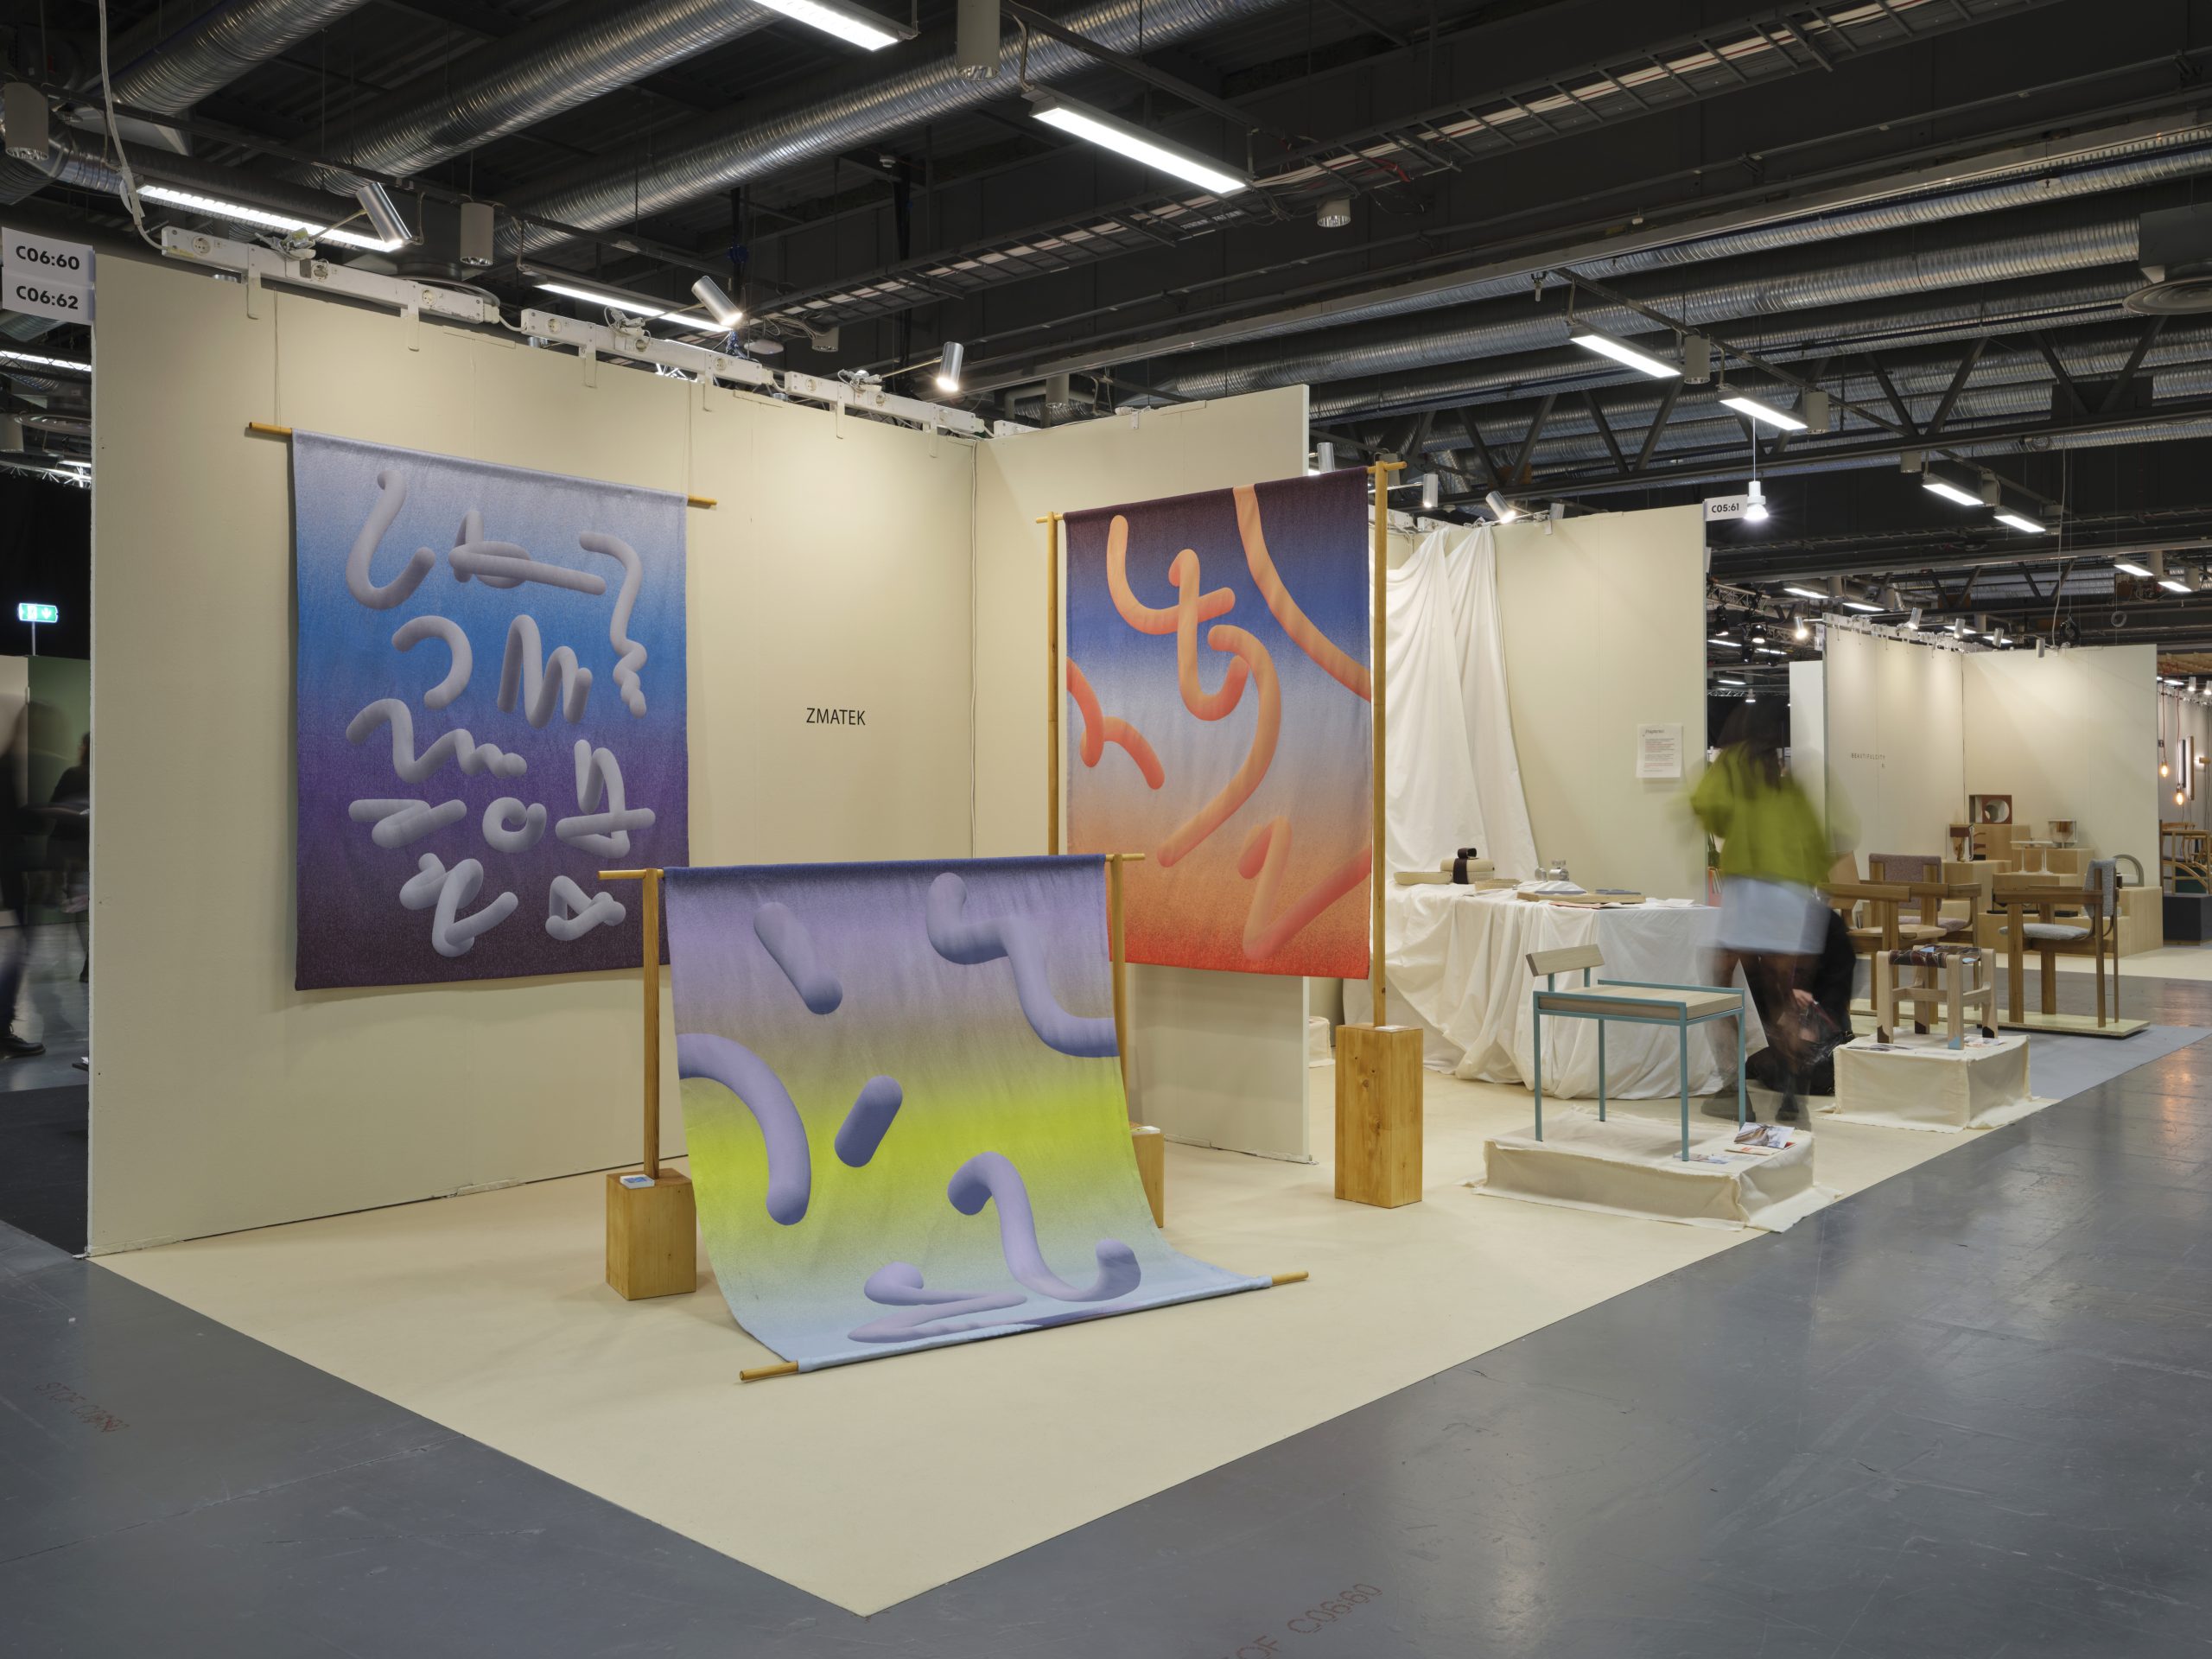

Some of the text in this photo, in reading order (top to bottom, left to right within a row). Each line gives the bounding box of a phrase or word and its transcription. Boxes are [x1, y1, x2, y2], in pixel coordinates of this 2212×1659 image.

[16, 245, 80, 270] C06:60
[16, 285, 79, 310] C06:62
[1711, 503, 1739, 512] C05:61
[806, 707, 866, 726] ZMATEK
[1287, 1583, 1382, 1633] C06:60
